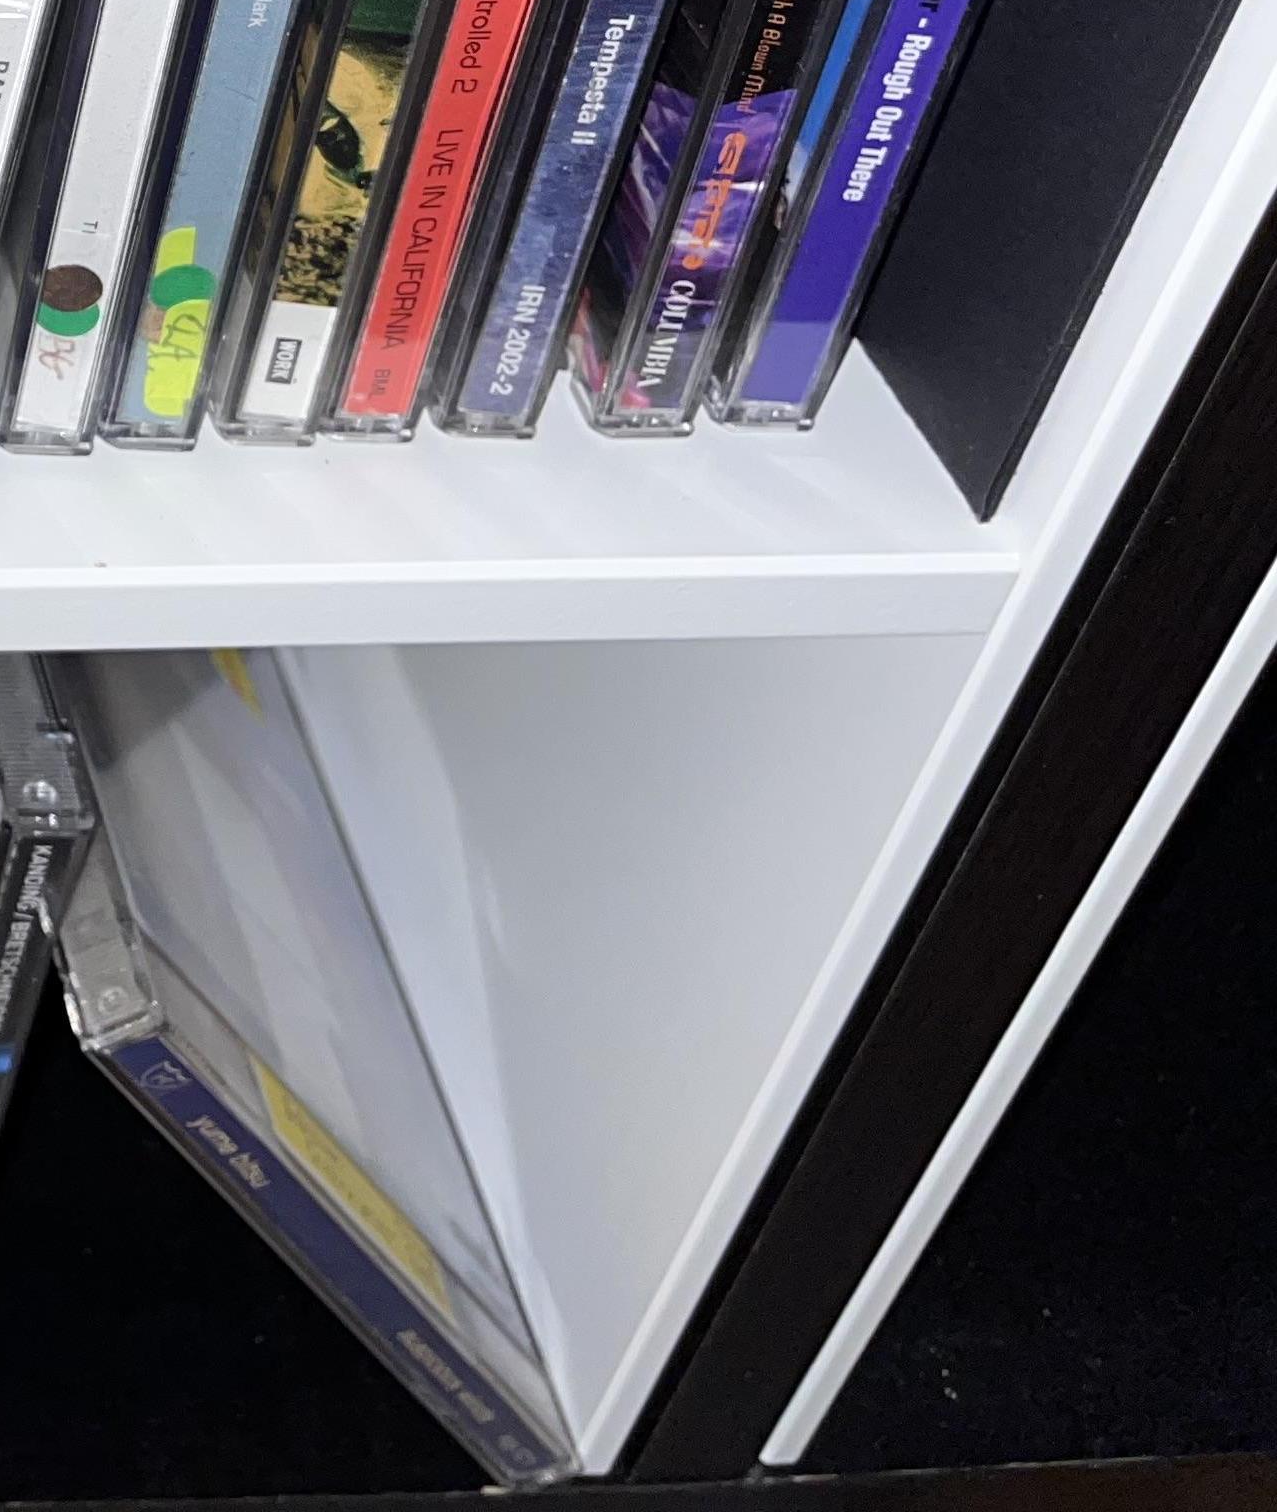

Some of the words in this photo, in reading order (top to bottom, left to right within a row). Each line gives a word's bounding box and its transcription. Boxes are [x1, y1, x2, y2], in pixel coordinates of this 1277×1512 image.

[576, 14, 636, 125] Tempesta
[882, 33, 934, 101] Rough
[865, 105, 904, 142] Out
[426, 128, 465, 178] LIVE
[842, 146, 889, 202] There
[417, 184, 448, 210] IN
[377, 216, 438, 352] CALIFORNIA
[511, 284, 547, 324] IRN
[270, 340, 298, 380] WORK
[488, 327, 531, 396] 2002-2
[634, 278, 696, 389] COLUMBIA
